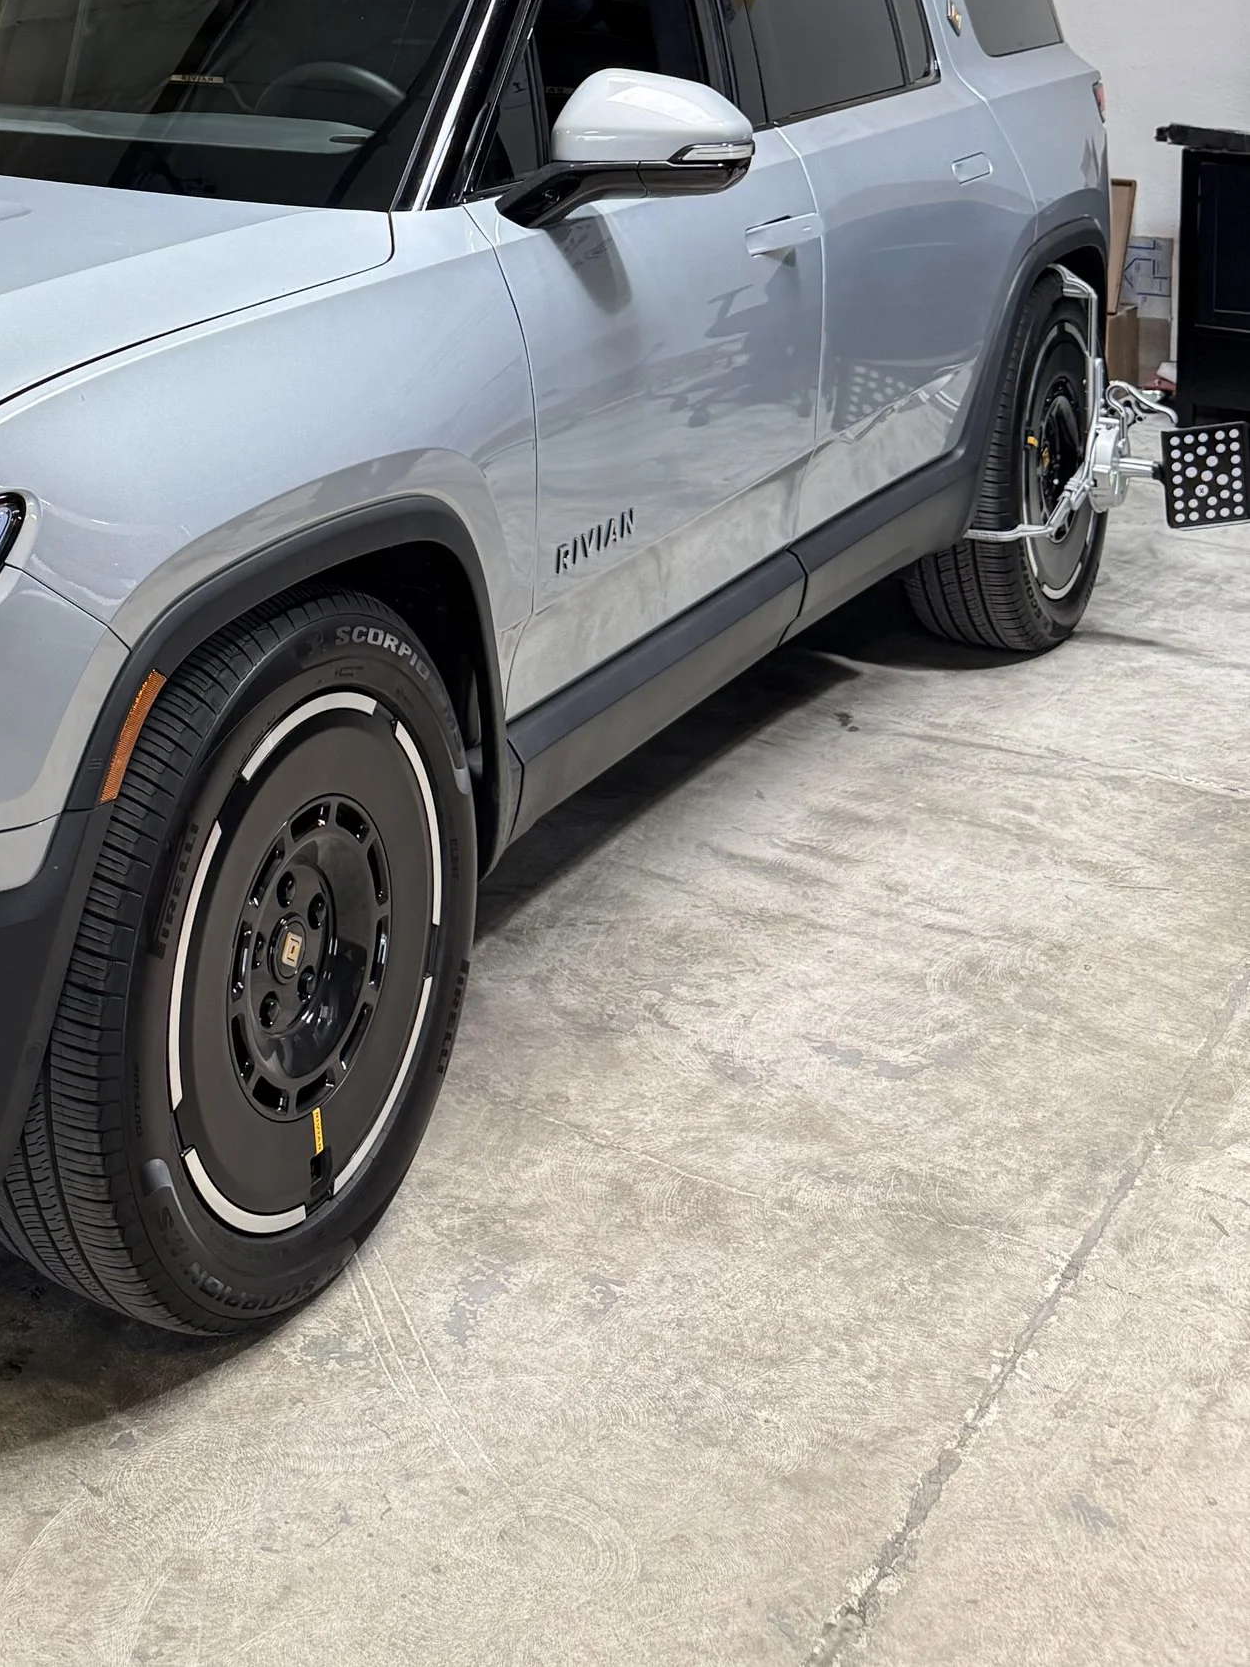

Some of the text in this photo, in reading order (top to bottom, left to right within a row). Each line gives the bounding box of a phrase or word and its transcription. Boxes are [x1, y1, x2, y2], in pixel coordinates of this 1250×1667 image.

[555, 507, 638, 574] RIVIAN
[334, 625, 434, 684] SCORPIO
[146, 823, 200, 960] PIRELLI
[182, 1261, 319, 1311] SCORPION
